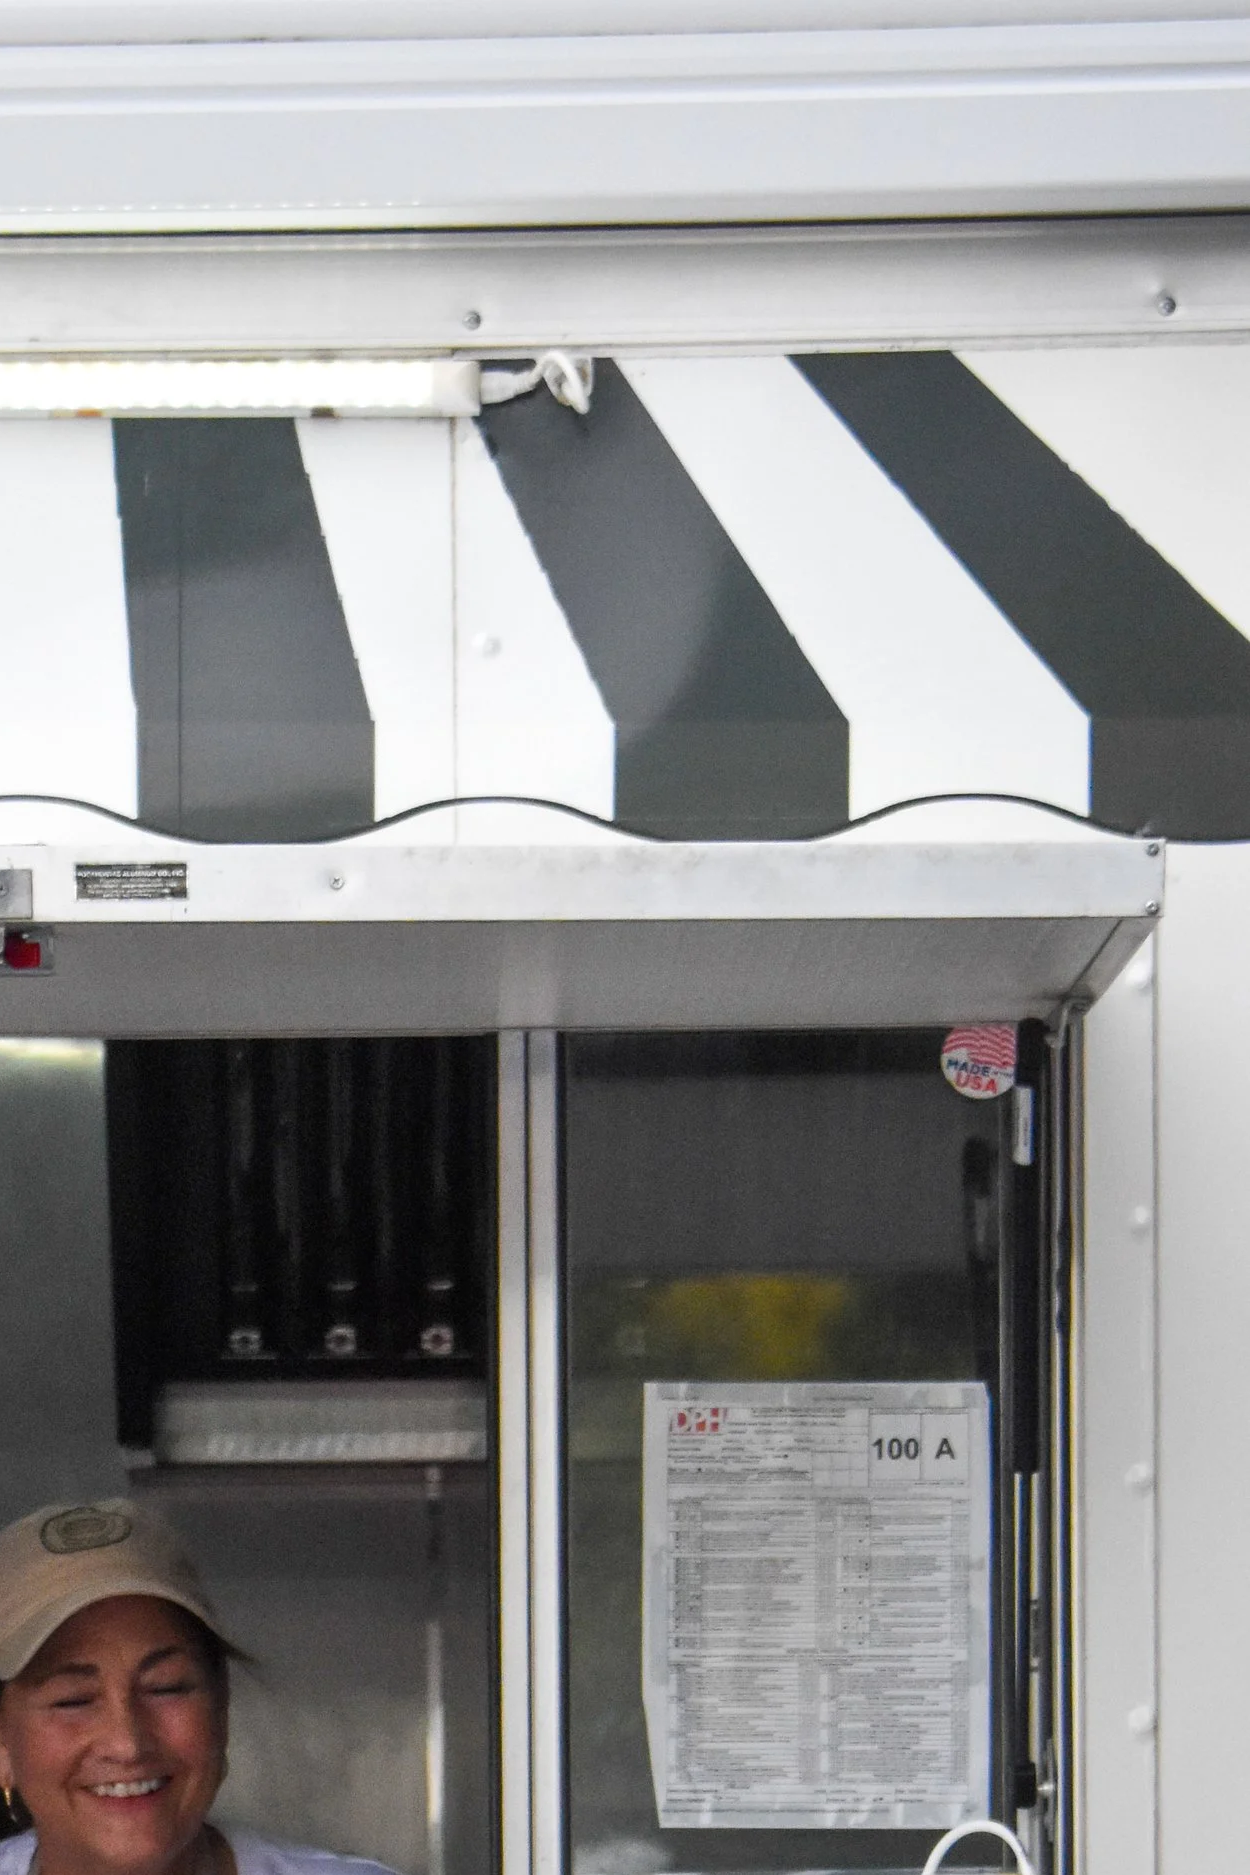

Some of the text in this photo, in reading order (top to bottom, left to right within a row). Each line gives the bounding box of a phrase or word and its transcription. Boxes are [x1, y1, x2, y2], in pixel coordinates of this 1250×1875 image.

[946, 1058, 991, 1077] MADE
[956, 1071, 998, 1094] USA
[872, 1436, 920, 1461] 100
[934, 1436, 957, 1461] A
